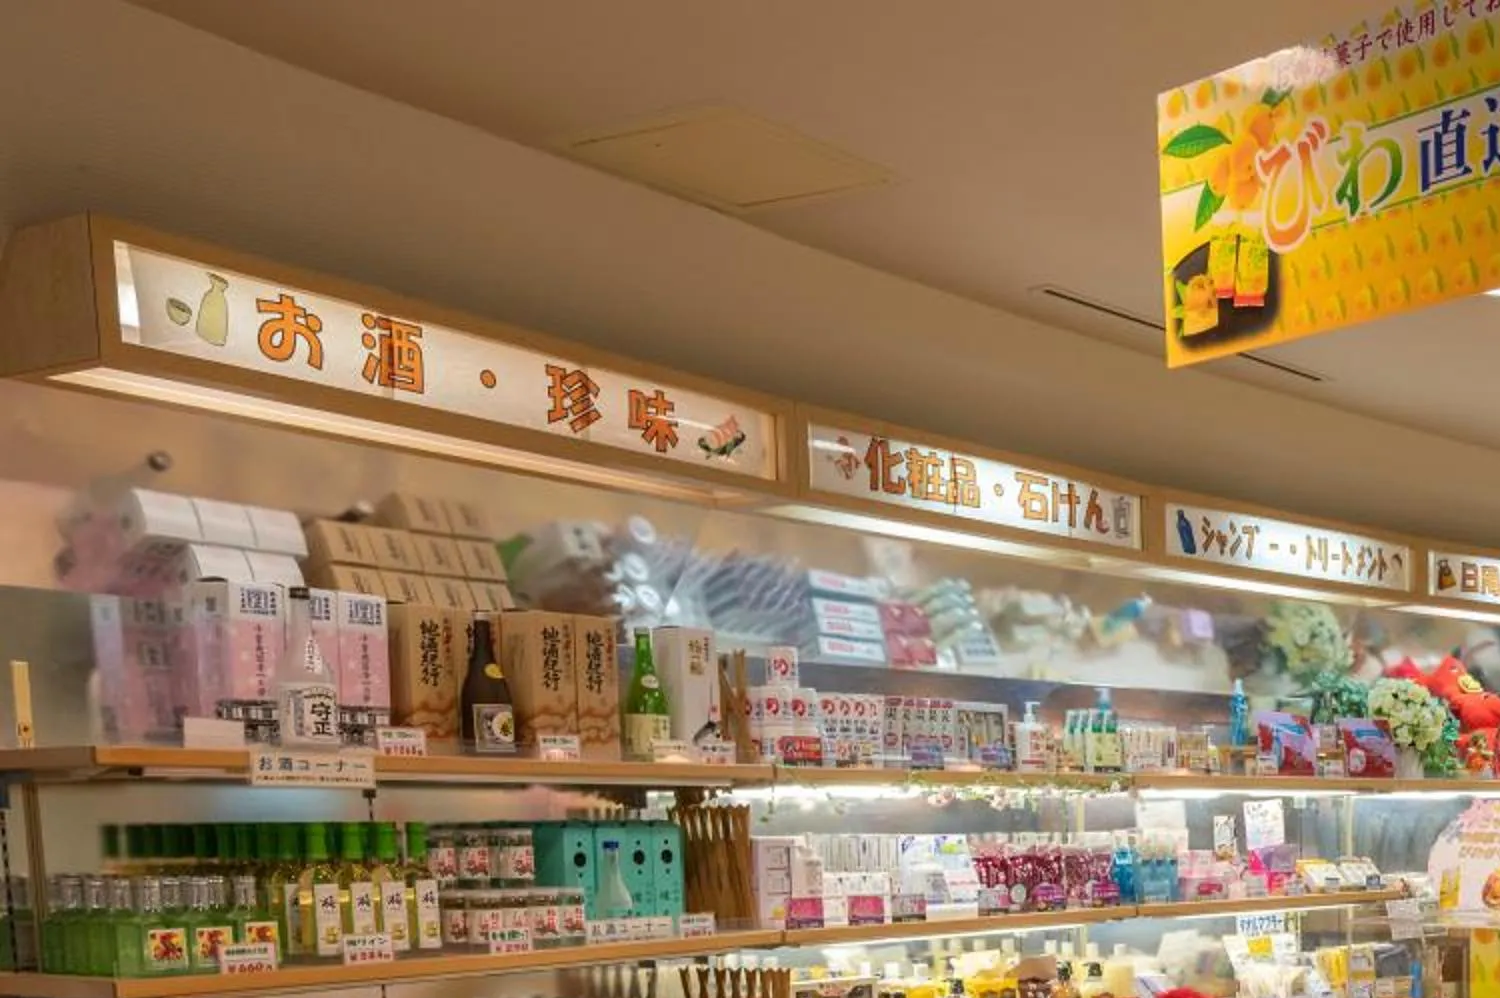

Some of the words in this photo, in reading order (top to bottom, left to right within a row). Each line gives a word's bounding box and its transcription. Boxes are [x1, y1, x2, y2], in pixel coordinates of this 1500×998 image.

[256, 293, 680, 453] お酒・珍味
[864, 435, 1110, 534] 化粧品・石けん
[259, 755, 366, 772] お酒コーナー
